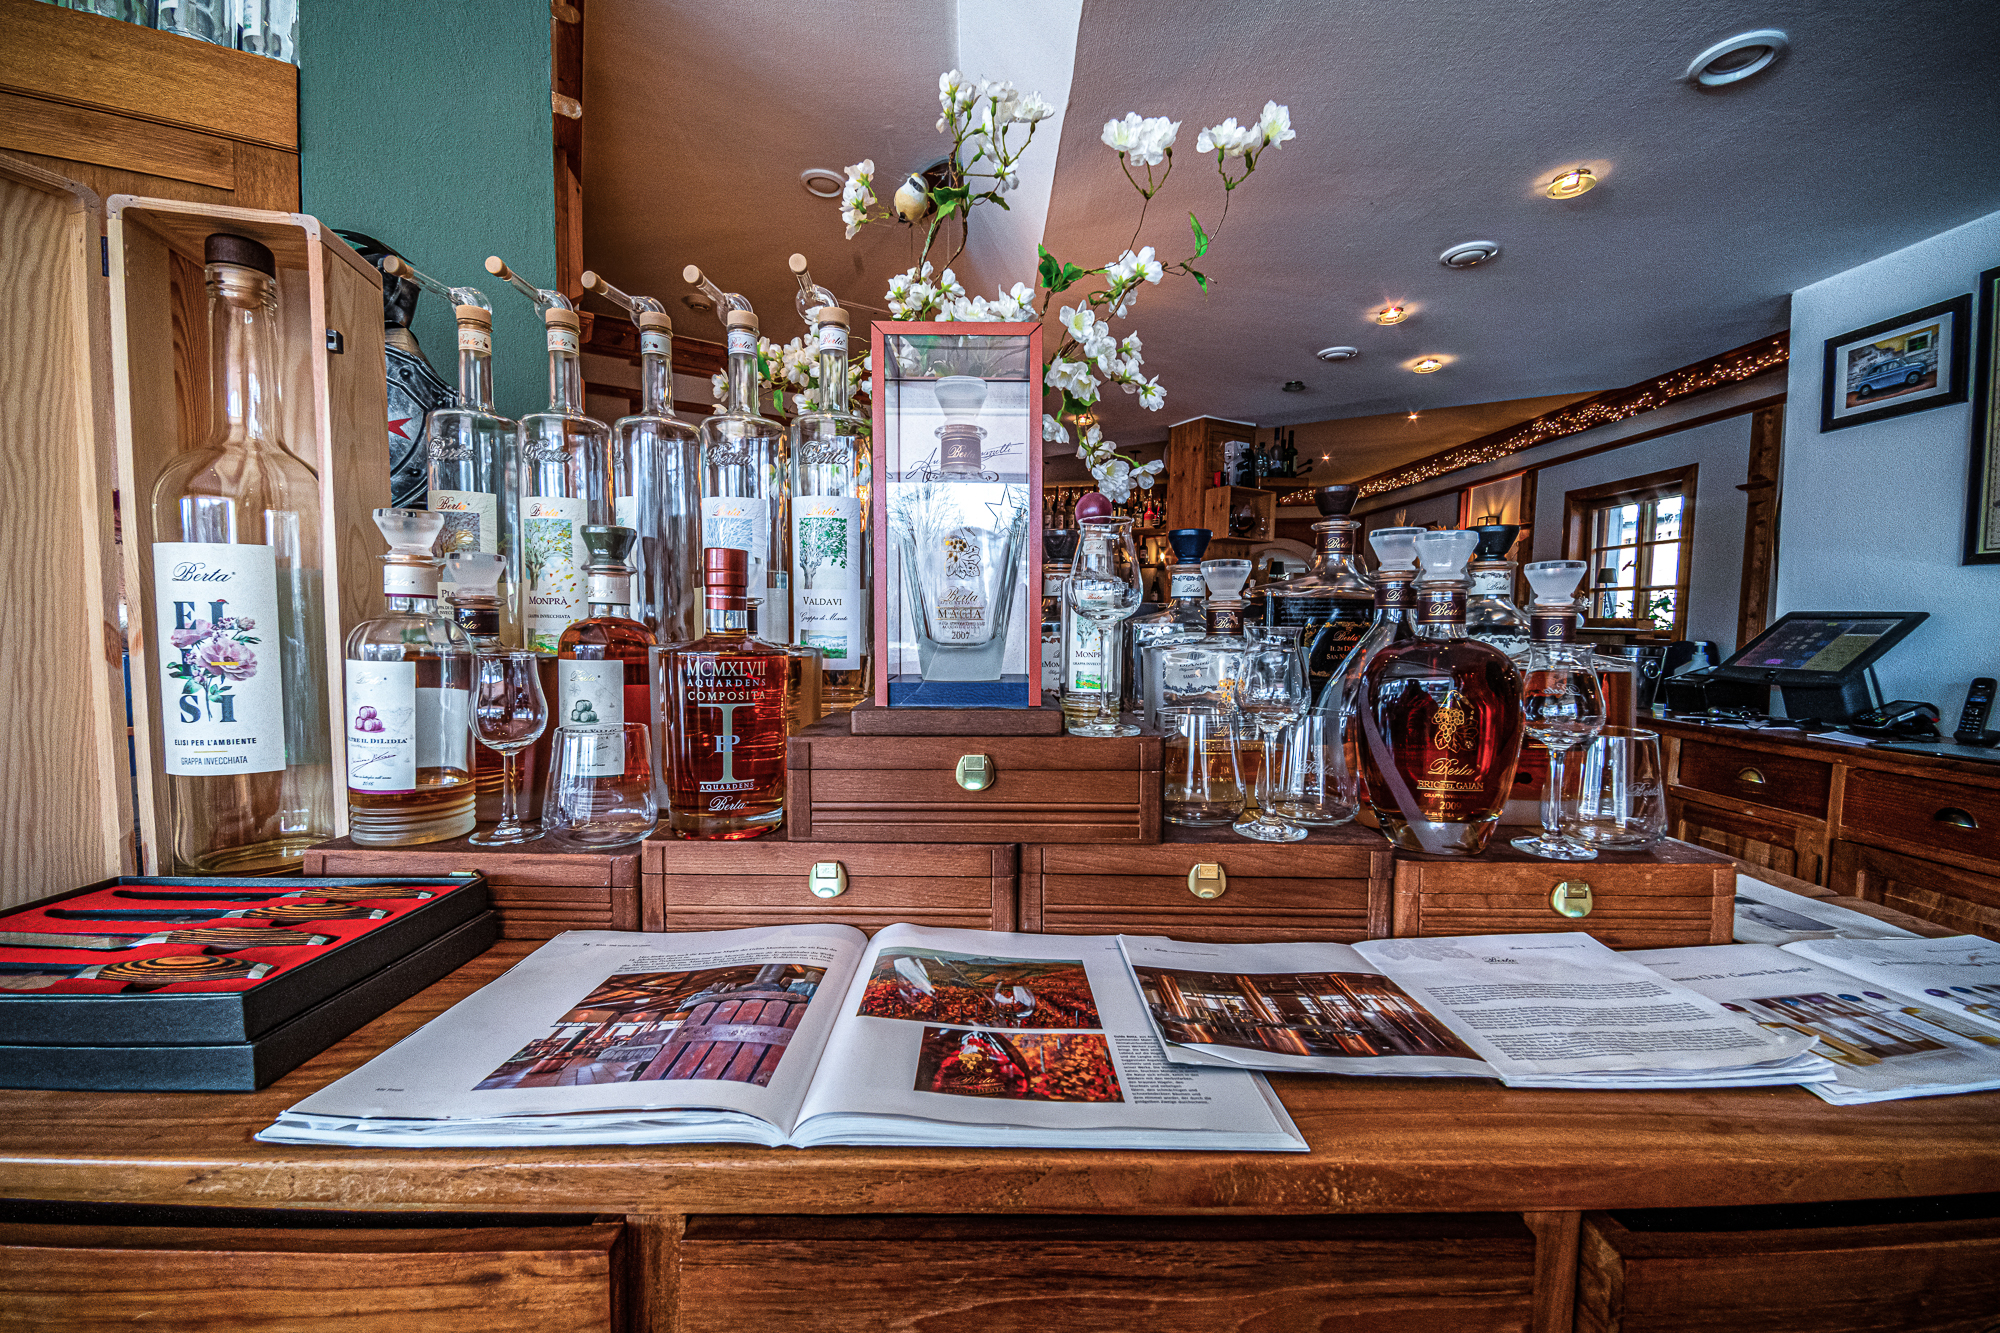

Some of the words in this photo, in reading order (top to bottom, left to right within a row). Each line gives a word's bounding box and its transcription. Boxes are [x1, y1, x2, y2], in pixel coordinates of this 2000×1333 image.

[821, 333, 844, 346] Berta
[436, 496, 466, 510] Berta
[530, 503, 559, 517] Berta
[713, 502, 743, 516] Berta
[806, 502, 836, 516] Berta
[172, 562, 232, 582] Berta
[1182, 584, 1202, 593] Berta
[1487, 583, 1509, 591] Berta
[940, 586, 978, 602] Berta
[529, 596, 568, 605] MONPRÀ
[803, 597, 842, 606] VALDAVI
[800, 611, 819, 622] Grappa
[952, 631, 970, 640] 2007
[686, 661, 766, 677] MCMXLVII
[687, 679, 766, 688] AQUARDENS
[687, 690, 766, 701] COMPOSITA
[207, 737, 257, 746] L'AMBIENTE
[181, 757, 203, 765] GRAPPA
[203, 756, 248, 765] INVECCHIATA
[1427, 757, 1476, 776] Berta
[700, 782, 754, 791] AQUARDENS
[1456, 781, 1484, 790] GAIAN
[708, 795, 748, 811] Berta
